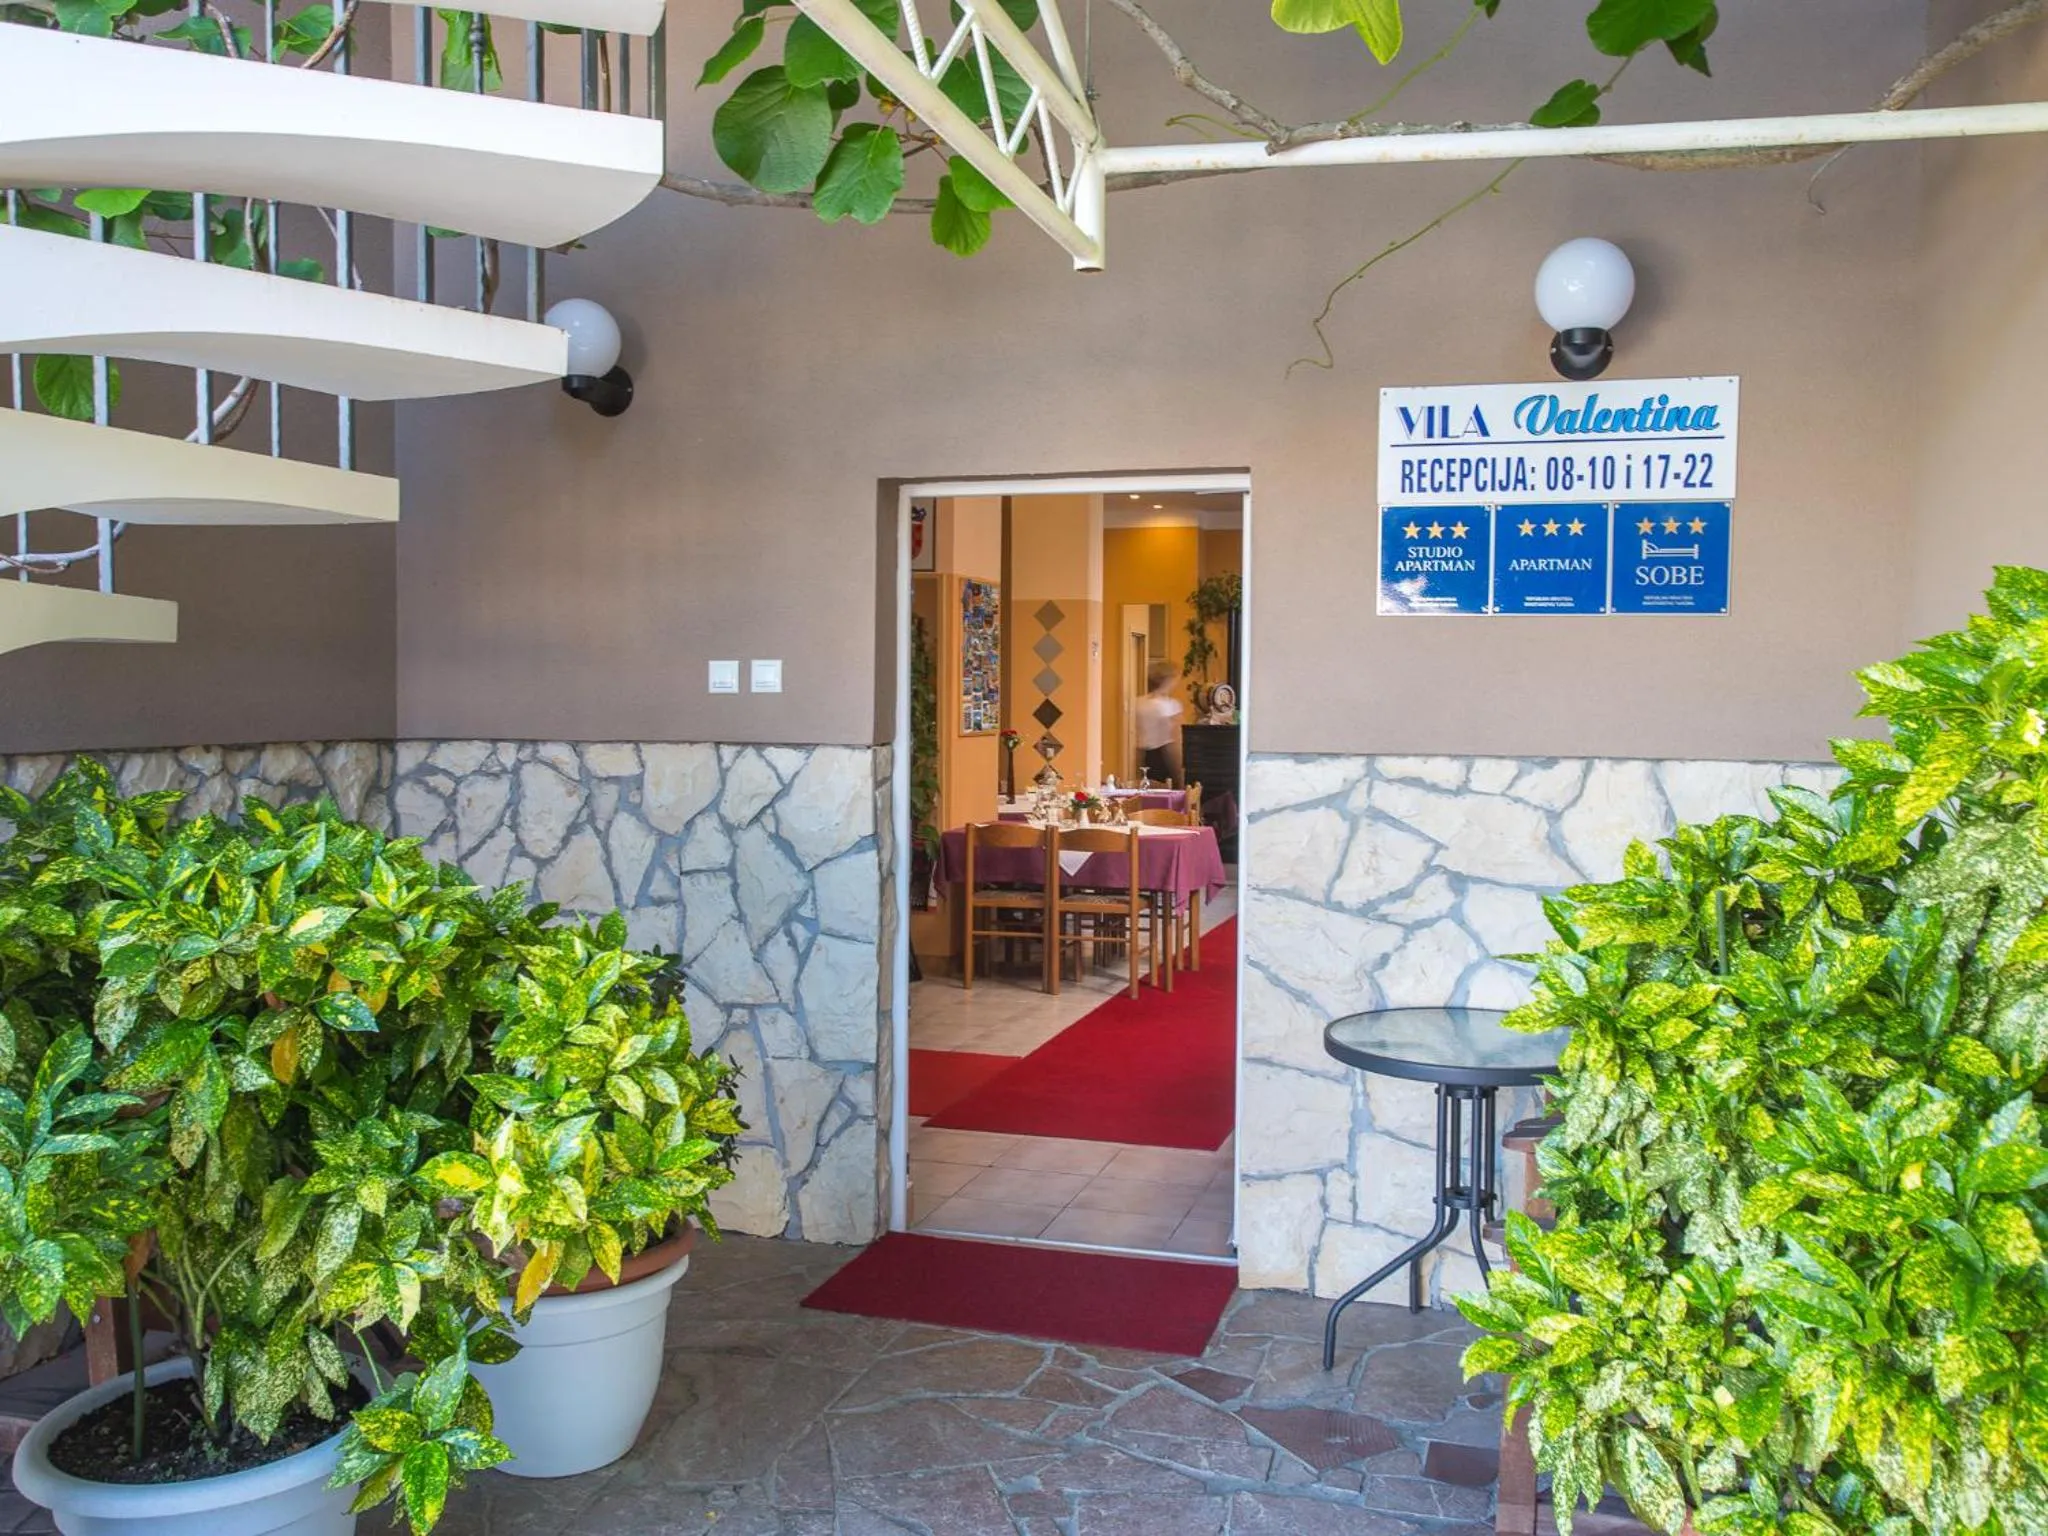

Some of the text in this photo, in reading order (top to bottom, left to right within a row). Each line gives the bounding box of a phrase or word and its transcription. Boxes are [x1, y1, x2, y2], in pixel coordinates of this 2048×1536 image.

[1395, 393, 1721, 440] VILA Valentina
[1401, 453, 1714, 493] RECEPCIJA: 08-10 i 17-22
[1407, 546, 1463, 558] STUDIO
[1395, 559, 1476, 572] APARTMAN
[1508, 558, 1592, 571] APARTMAN
[1635, 565, 1705, 586] SOBE
